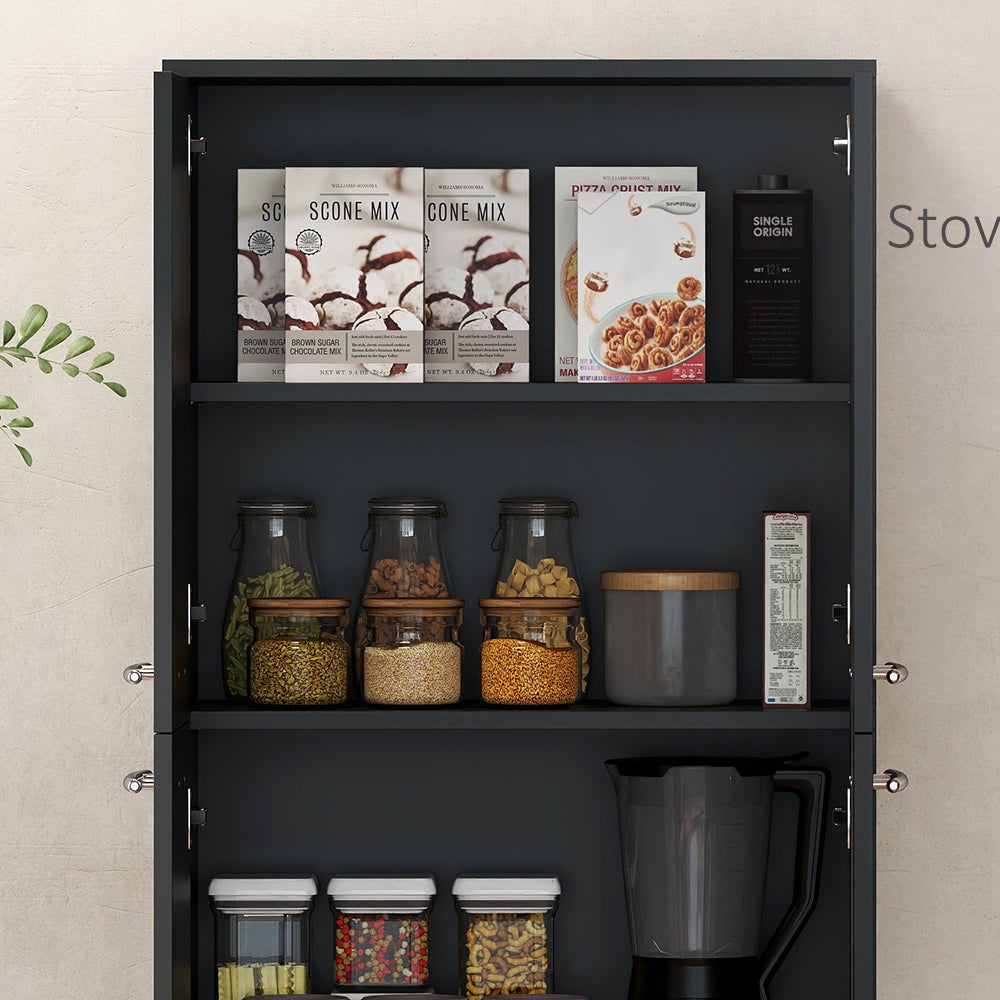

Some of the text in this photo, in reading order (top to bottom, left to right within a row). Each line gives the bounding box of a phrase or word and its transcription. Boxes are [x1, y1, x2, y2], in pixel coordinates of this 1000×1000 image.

[262, 202, 285, 222] SC
[310, 201, 400, 220] SCONE MIX
[478, 202, 506, 222] MIX
[753, 216, 792, 226] SINGLE
[753, 227, 792, 236] ORIGIN
